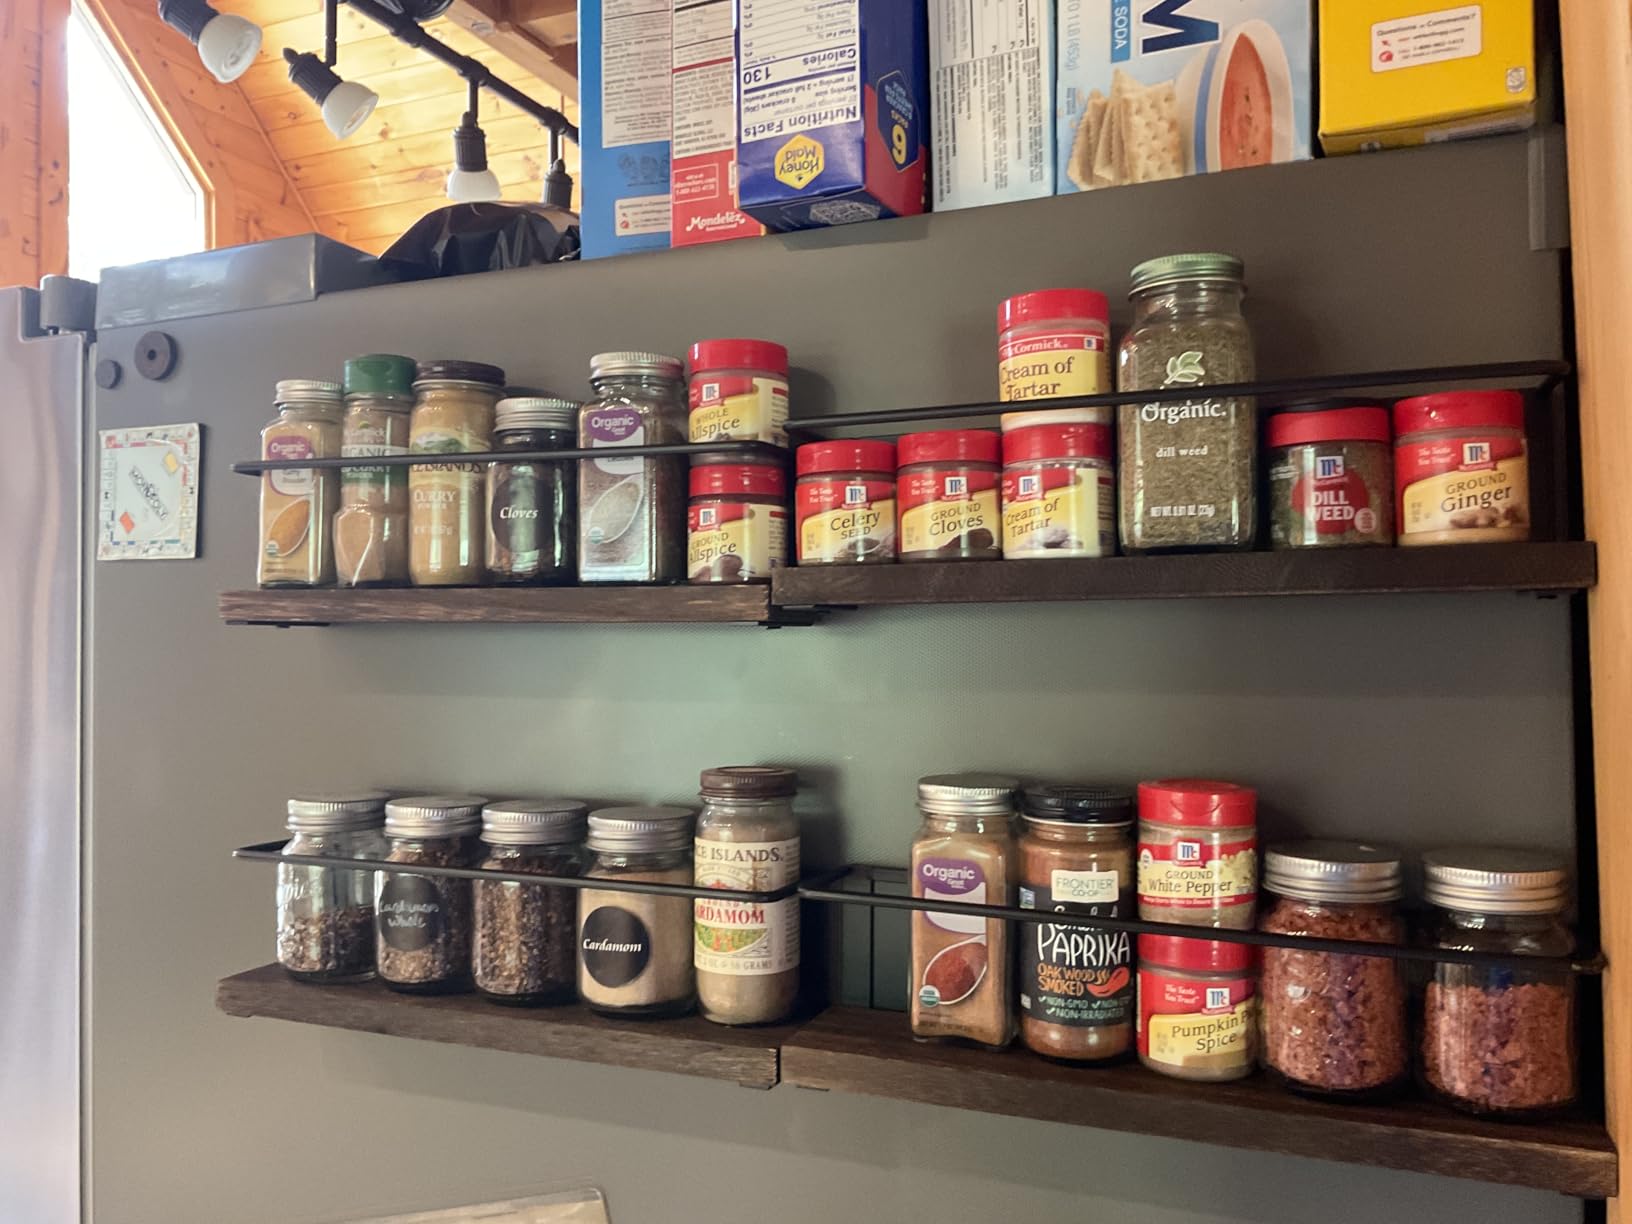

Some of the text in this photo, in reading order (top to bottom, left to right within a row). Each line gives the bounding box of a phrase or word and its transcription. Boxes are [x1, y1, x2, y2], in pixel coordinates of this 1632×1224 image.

[1115, 7, 1129, 50] SODA
[803, 48, 857, 65] Calories
[744, 67, 772, 84] 130
[744, 106, 857, 137] Nutrition Facts
[785, 145, 817, 161] Maid
[892, 124, 906, 164] 6
[779, 156, 819, 176] Honey
[1054, 356, 1075, 374] of
[1006, 383, 1061, 401] Tartar
[591, 413, 635, 432] Organic
[1156, 445, 1208, 458] dill weed
[1445, 472, 1508, 495] GROUND
[1044, 498, 1060, 512] of
[1313, 490, 1349, 506] DILL
[1441, 484, 1512, 513] Ginger
[499, 507, 539, 519] Cloves
[830, 511, 881, 531] Celery
[930, 503, 981, 522] GROUND
[841, 526, 871, 540] SEED
[929, 514, 984, 536] Cloves
[1011, 518, 1051, 538] Tartar
[922, 863, 975, 881] Organic
[1165, 870, 1214, 880] GROUND
[1056, 878, 1114, 890] FRONTIER
[1148, 877, 1233, 896] White Pepper
[696, 908, 766, 924] ARDAMOM
[583, 938, 642, 952] Cardamom
[1037, 922, 1131, 967] PAPRIKA
[1038, 976, 1084, 996] SMOKED
[1171, 1016, 1239, 1038] Pumpkin
[1196, 1032, 1237, 1053] Spice
